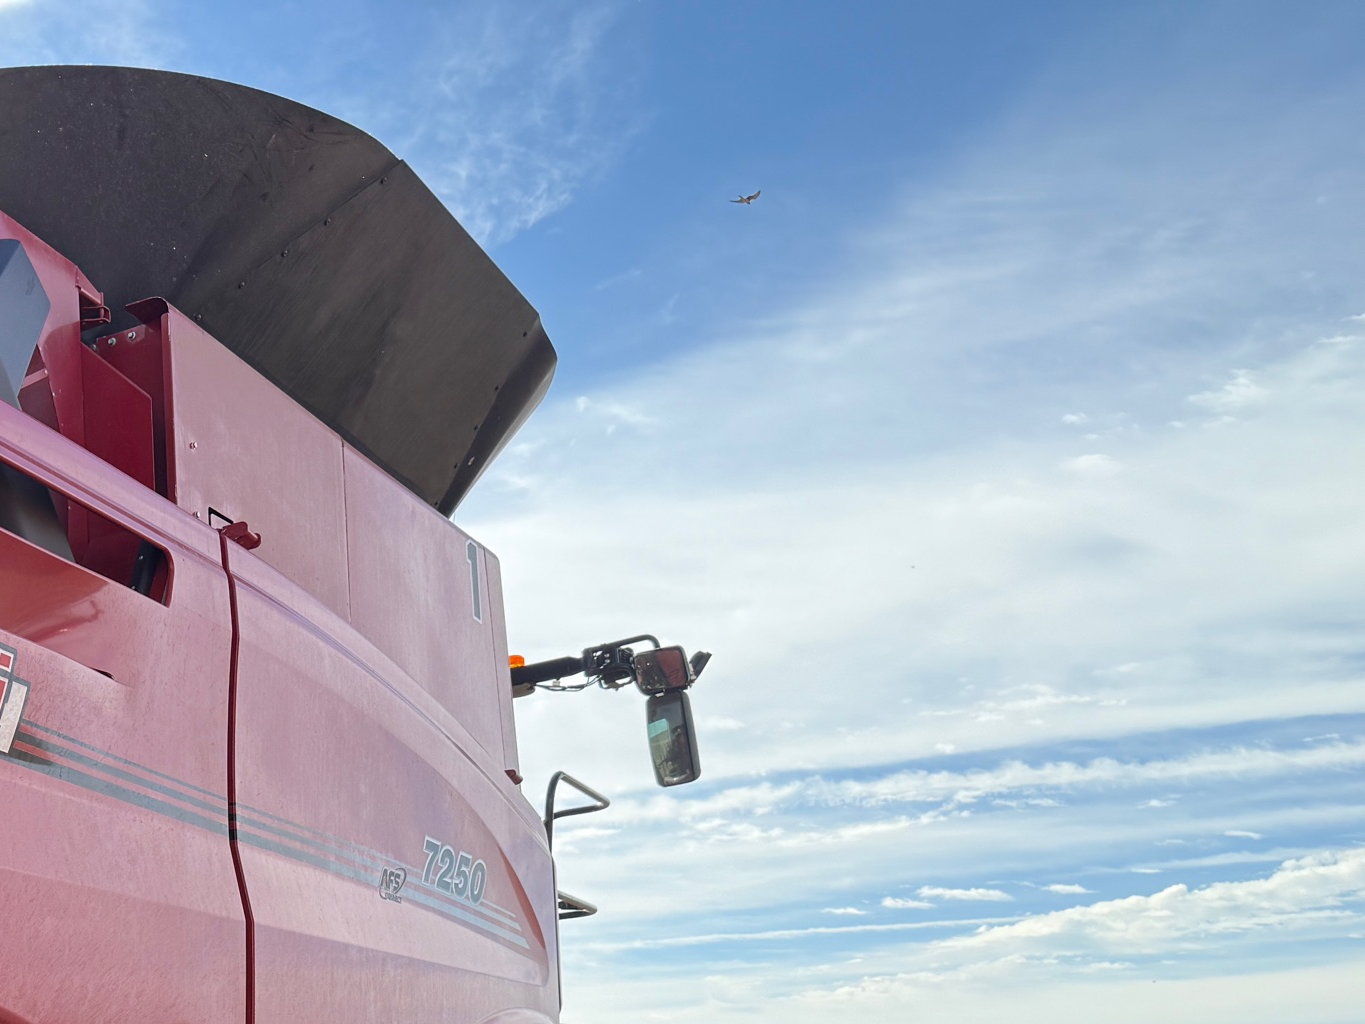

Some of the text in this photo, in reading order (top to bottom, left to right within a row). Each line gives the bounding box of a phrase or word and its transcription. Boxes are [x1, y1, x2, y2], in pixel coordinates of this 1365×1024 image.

[466, 539, 482, 624] 1
[380, 868, 401, 892] AFS
[422, 835, 487, 905] 7250
